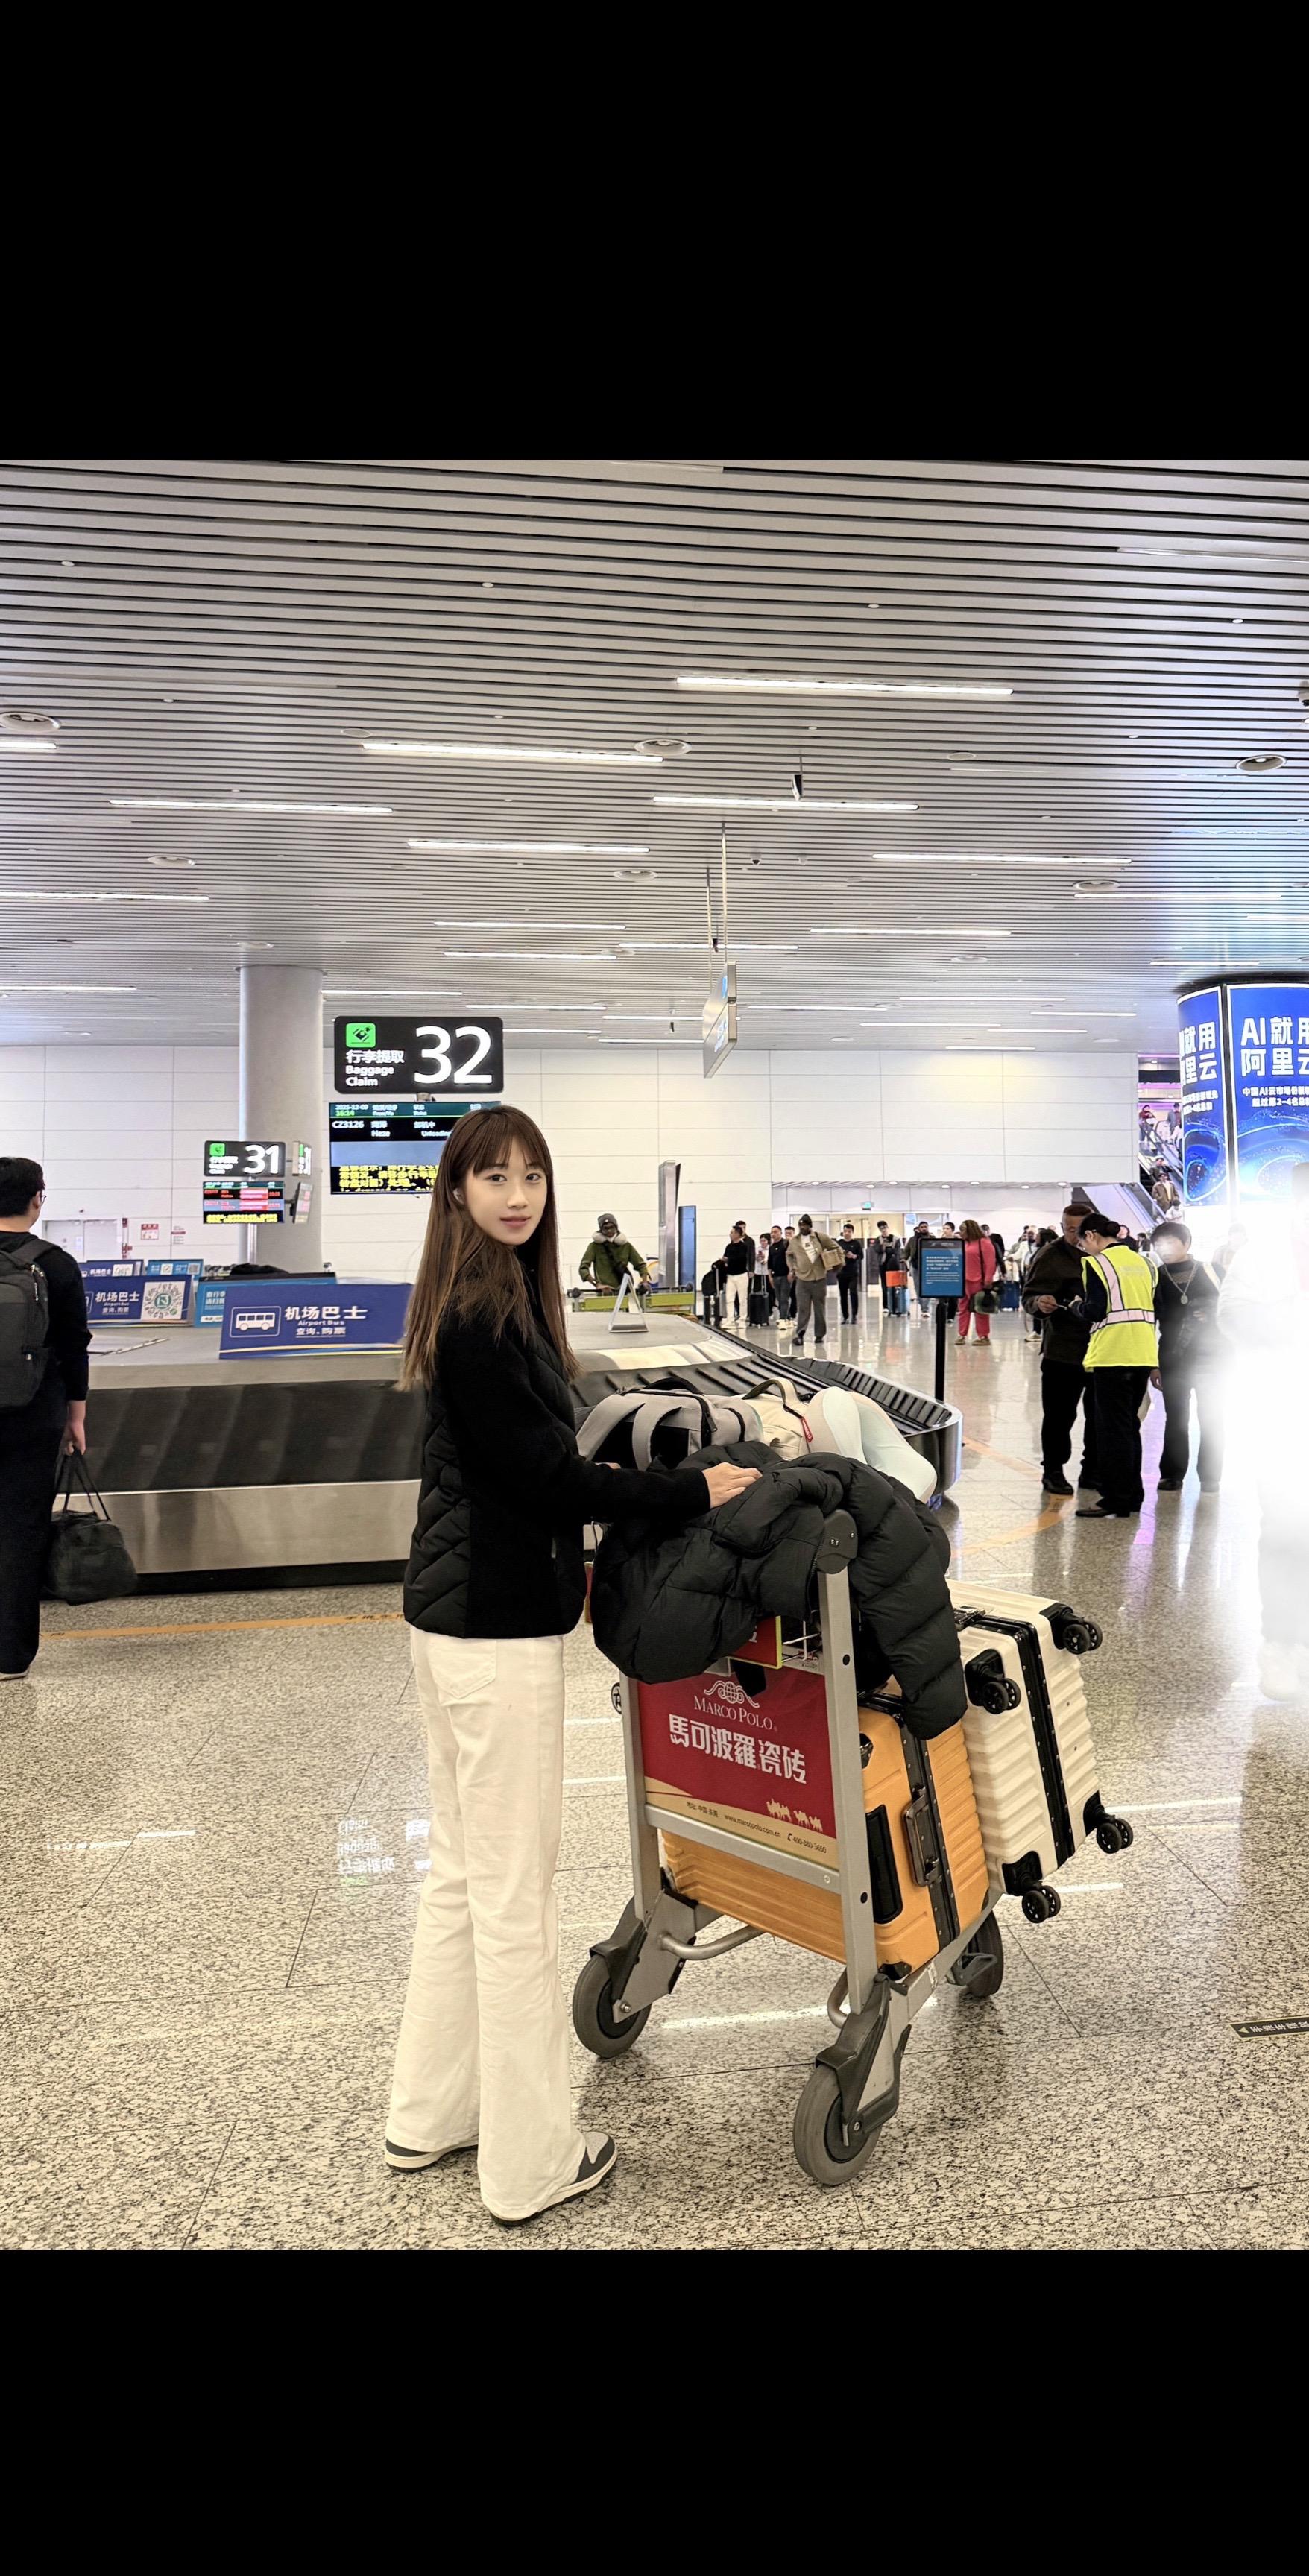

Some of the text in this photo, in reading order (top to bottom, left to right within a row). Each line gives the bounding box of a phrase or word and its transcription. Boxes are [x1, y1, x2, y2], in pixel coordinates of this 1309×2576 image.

[345, 1049, 405, 1064] 行李提取
[414, 1026, 492, 1084] 32
[345, 1066, 394, 1076] Baggage
[346, 1077, 379, 1087] Claim
[243, 1144, 280, 1174] 31
[95, 1291, 140, 1303] 机场巴士
[285, 1305, 368, 1321] 机场巴士
